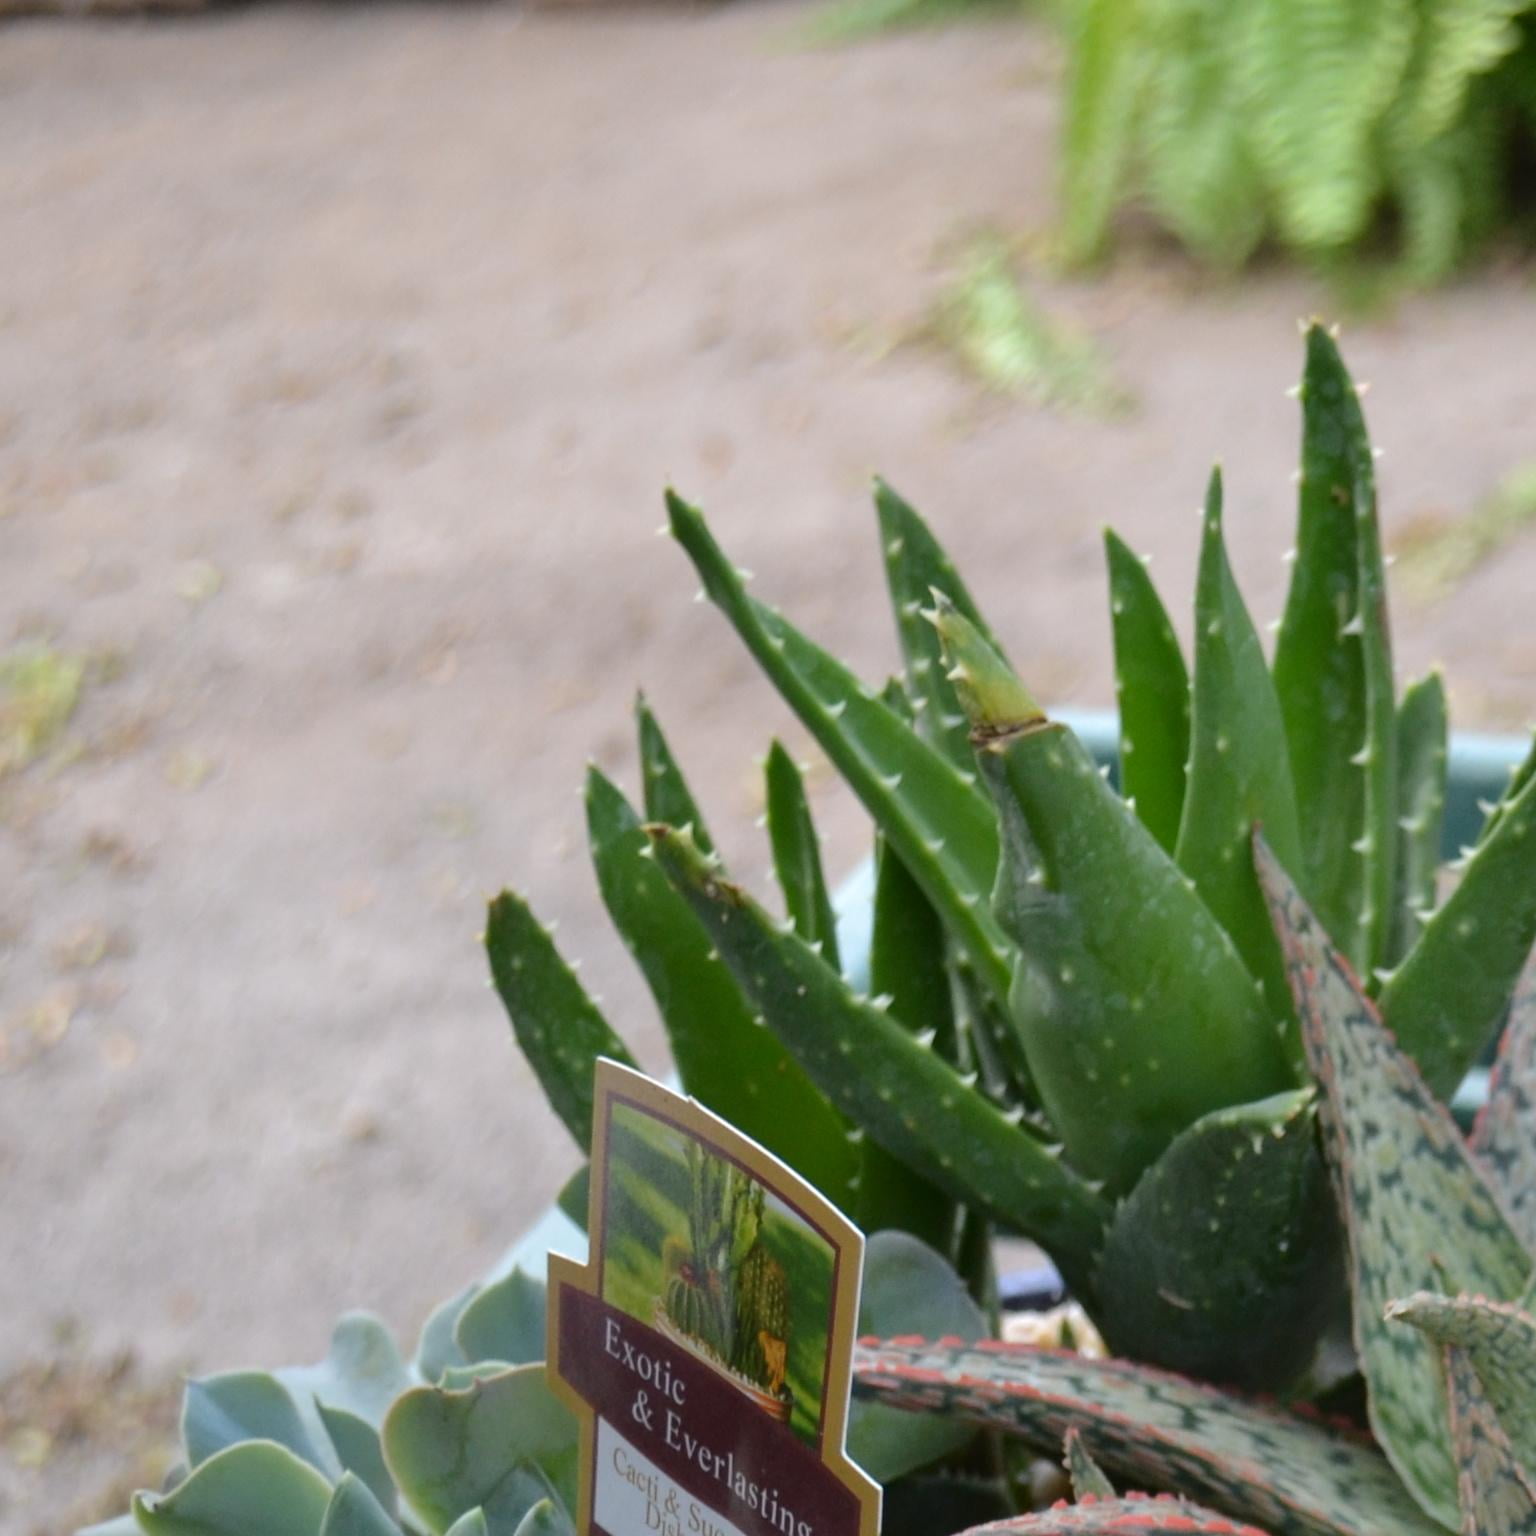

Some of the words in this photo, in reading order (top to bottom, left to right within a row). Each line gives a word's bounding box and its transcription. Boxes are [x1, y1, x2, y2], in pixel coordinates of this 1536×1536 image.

[605, 1316, 687, 1406] Exotic
[631, 1390, 653, 1432] &
[613, 1447, 659, 1503] Cacti
[664, 1486, 680, 1520] &
